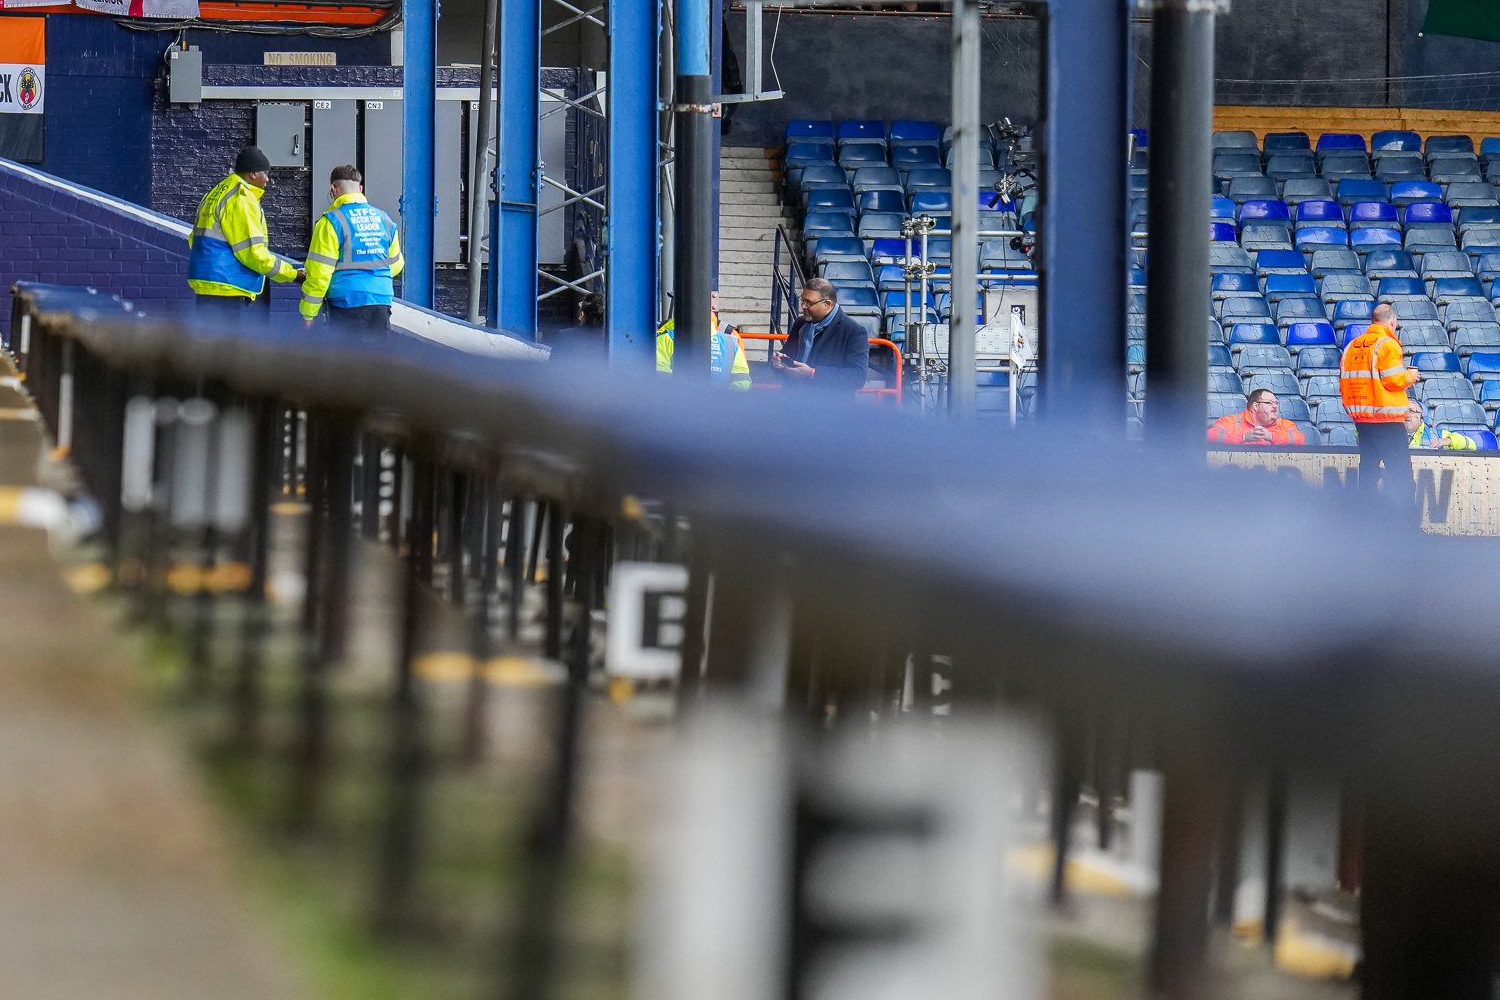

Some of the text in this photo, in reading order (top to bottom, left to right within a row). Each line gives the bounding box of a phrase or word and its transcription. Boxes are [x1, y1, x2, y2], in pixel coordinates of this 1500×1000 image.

[268, 52, 334, 66] NO SMOKING
[367, 102, 383, 110] CN3
[348, 208, 377, 217] LTFC
[356, 223, 380, 231] LEADER
